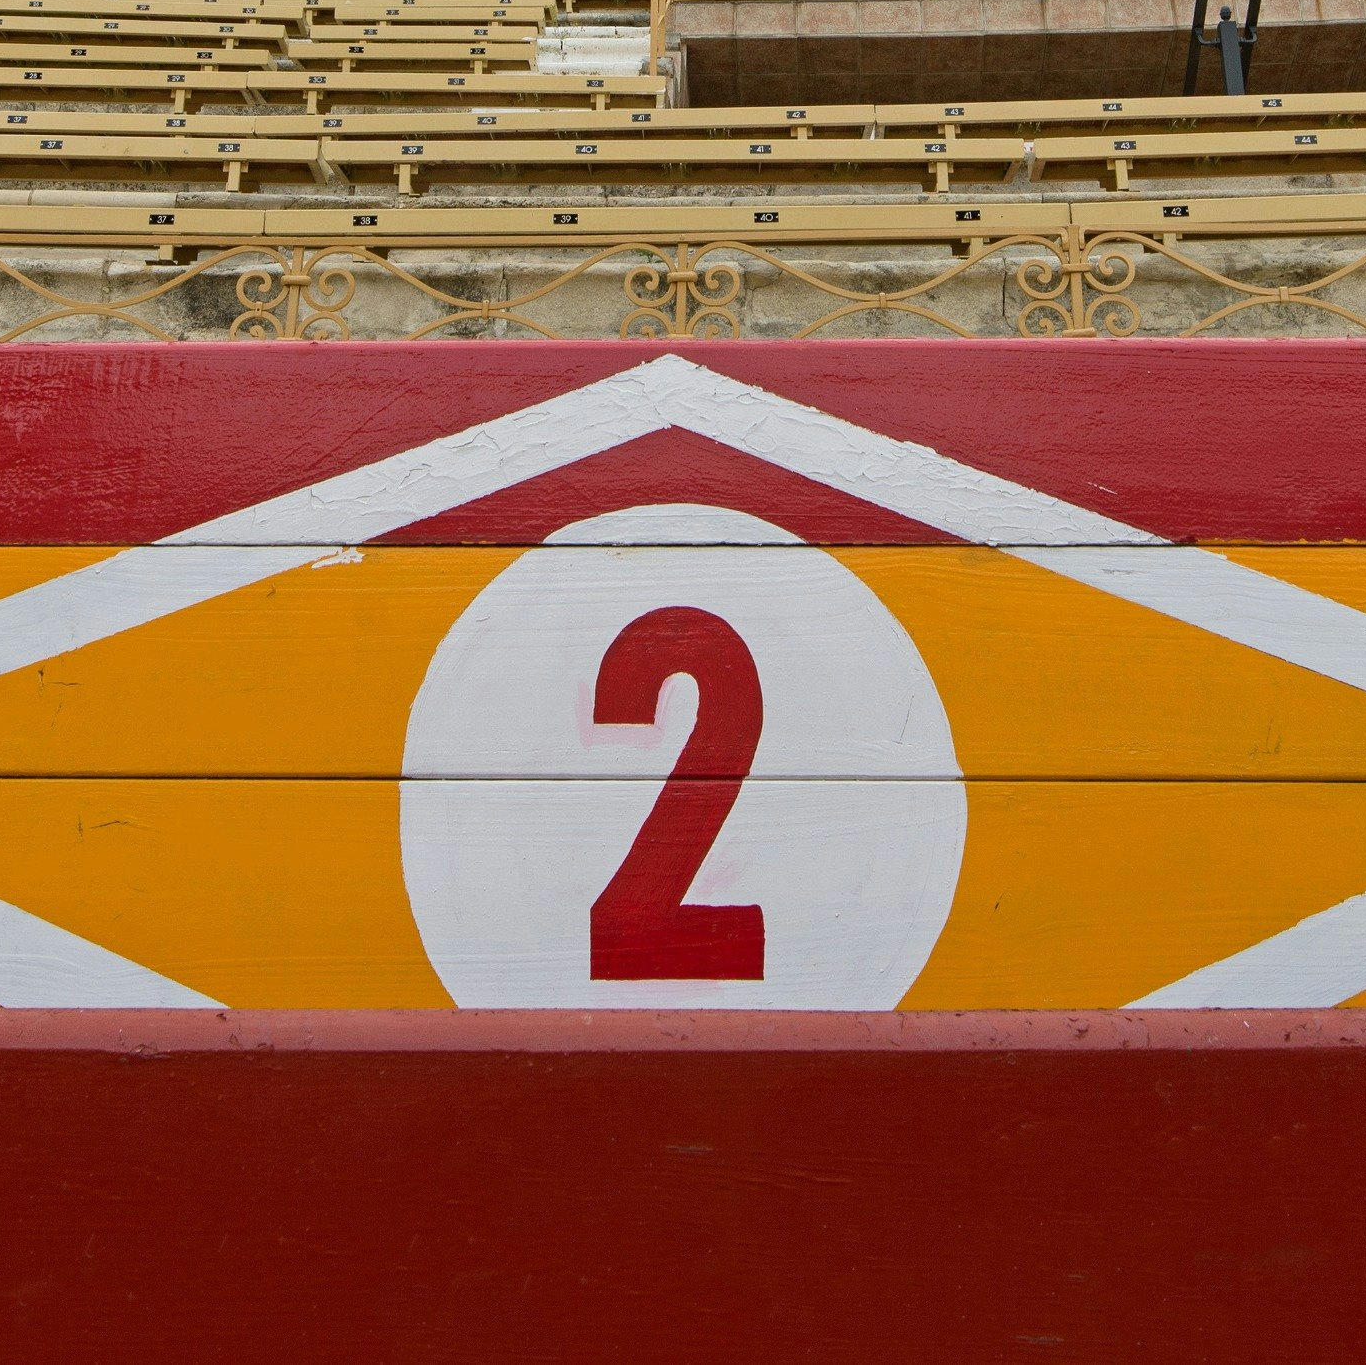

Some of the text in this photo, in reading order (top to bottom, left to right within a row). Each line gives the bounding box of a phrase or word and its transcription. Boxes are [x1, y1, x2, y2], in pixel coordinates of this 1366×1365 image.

[963, 211, 973, 220] 41
[1170, 207, 1182, 216] 42
[156, 215, 168, 224] 37
[360, 216, 371, 225] 38
[560, 214, 571, 223] 39
[760, 213, 774, 222] 40
[590, 605, 764, 981] 2
